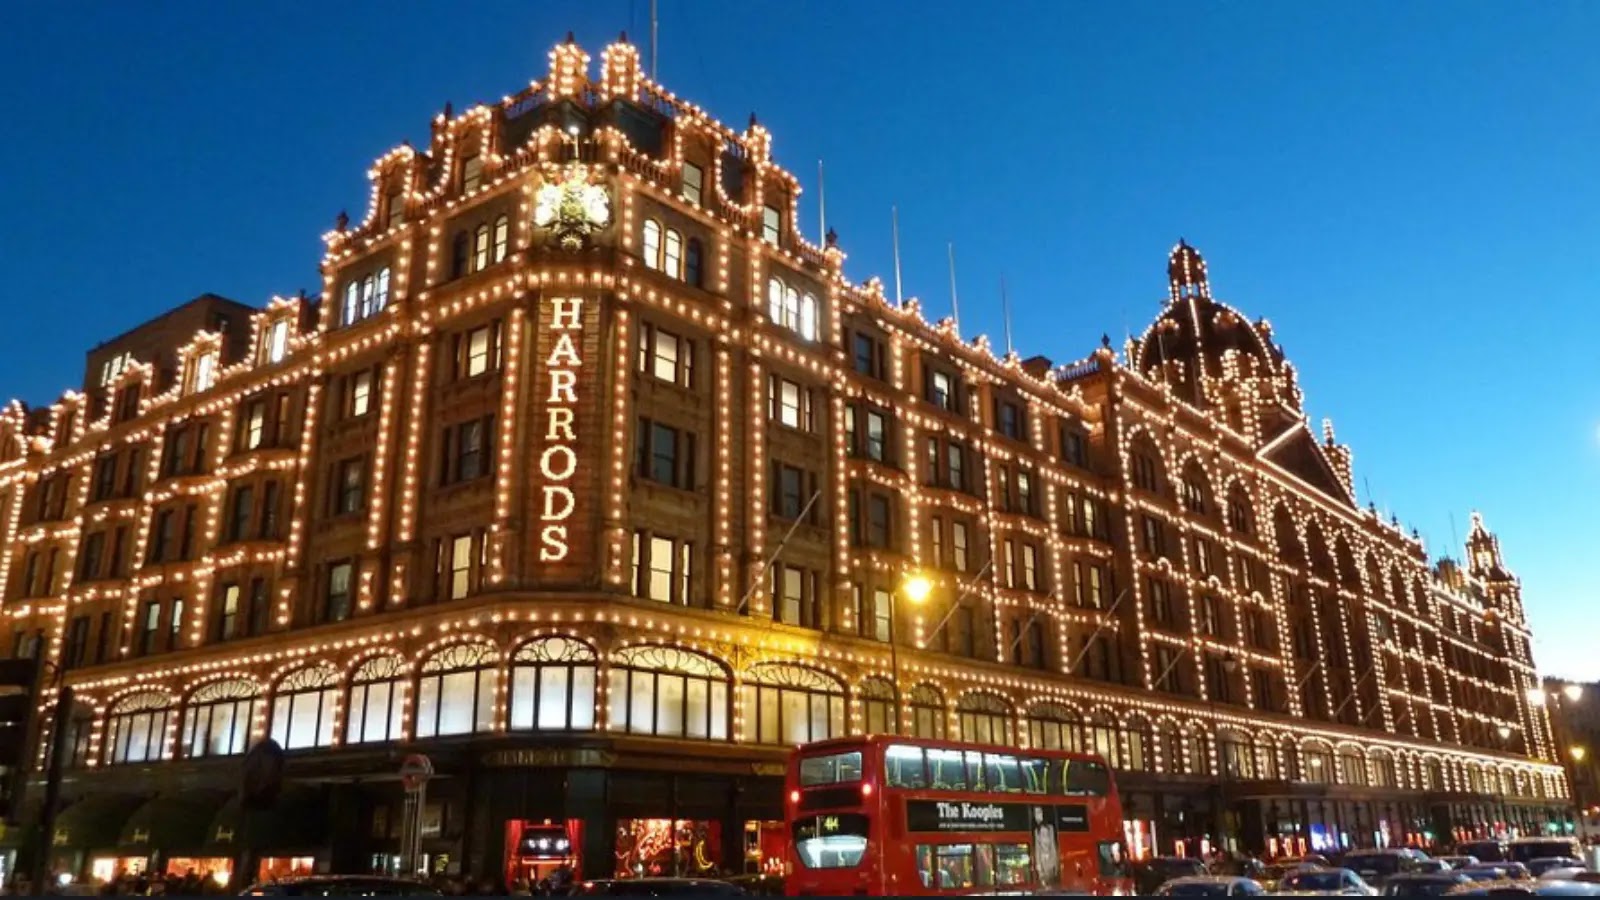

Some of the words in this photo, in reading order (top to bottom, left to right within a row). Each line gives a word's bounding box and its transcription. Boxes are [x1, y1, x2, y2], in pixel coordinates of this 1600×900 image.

[539, 297, 584, 562] HARRODS
[936, 802, 959, 818] The
[961, 802, 1003, 821] Kooples
